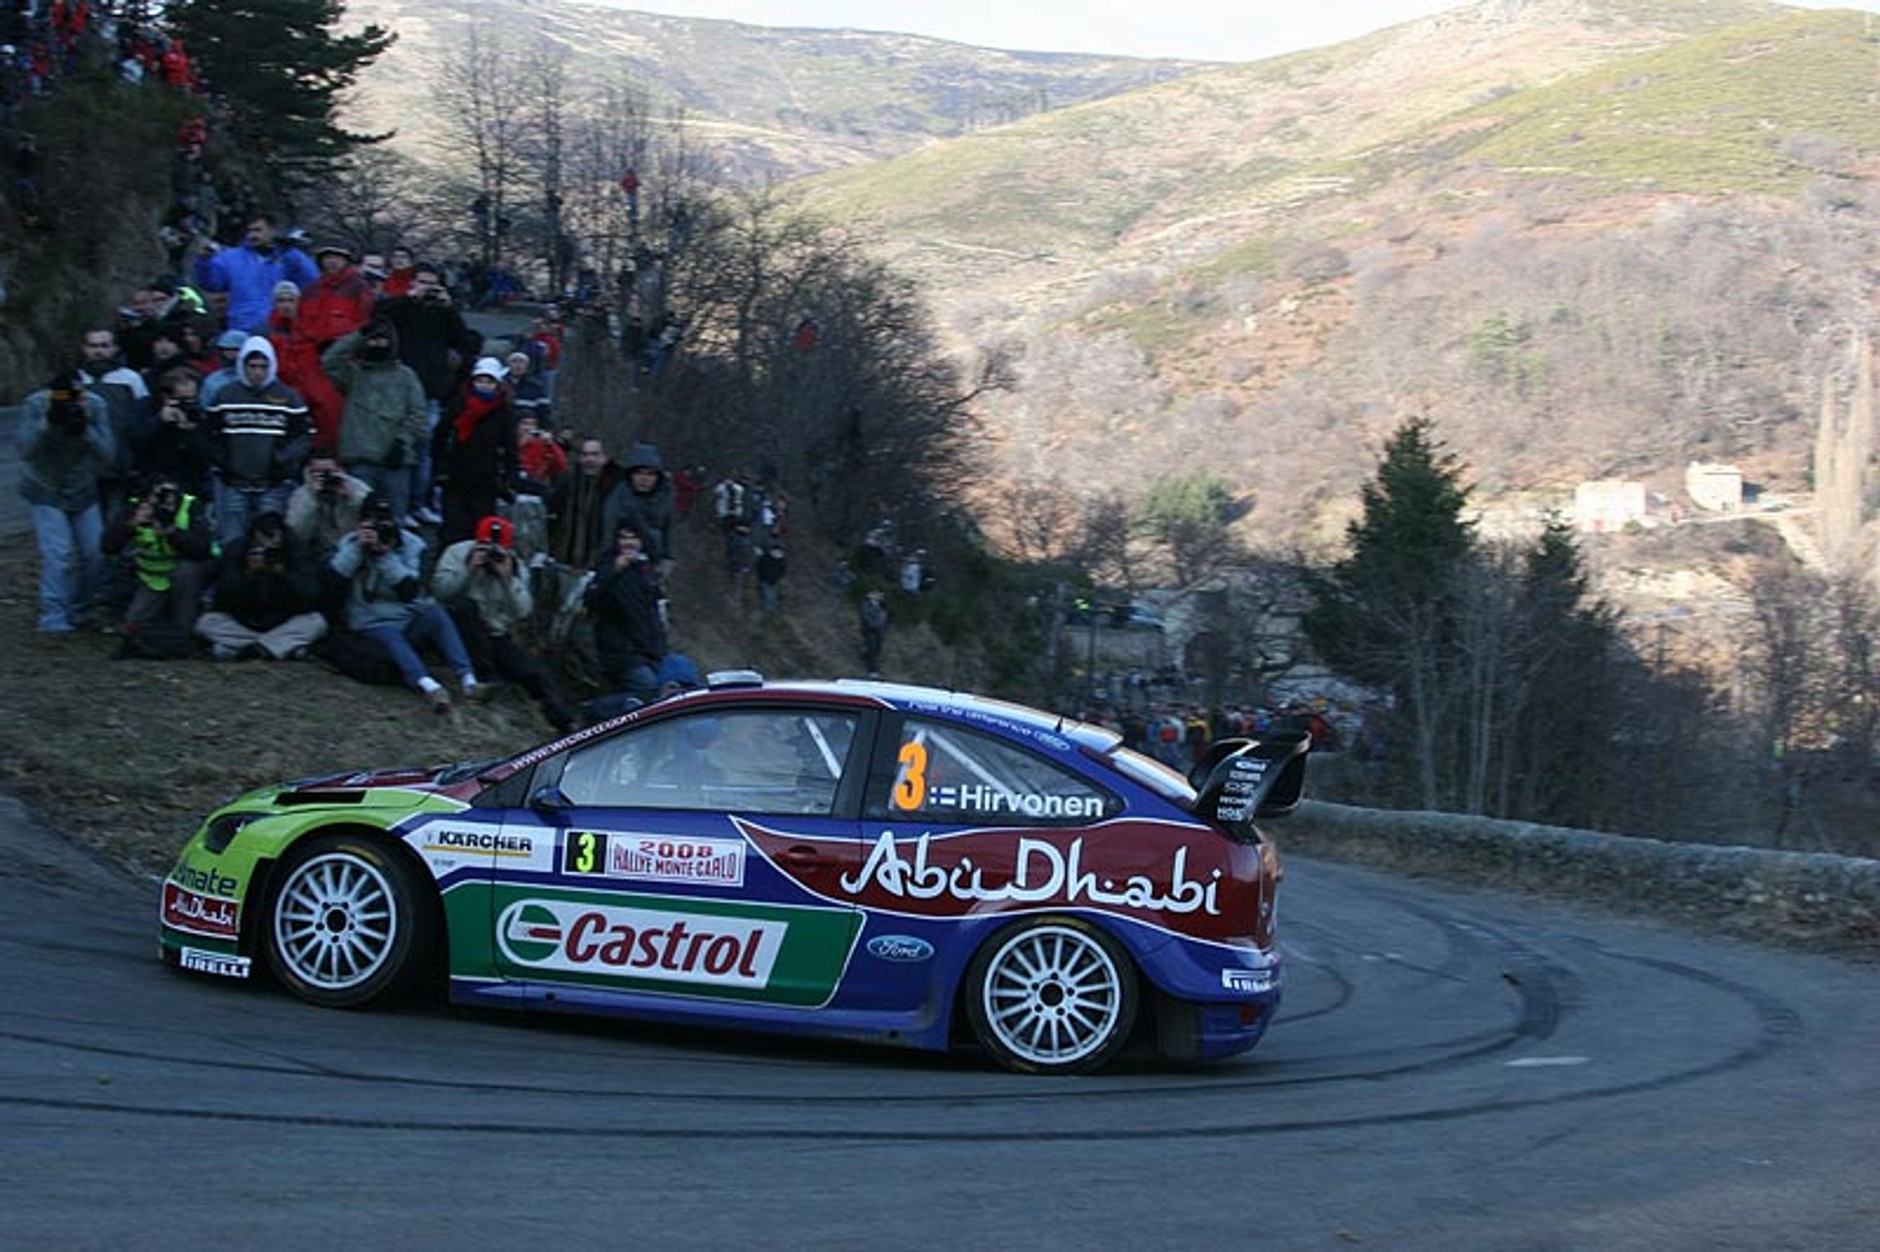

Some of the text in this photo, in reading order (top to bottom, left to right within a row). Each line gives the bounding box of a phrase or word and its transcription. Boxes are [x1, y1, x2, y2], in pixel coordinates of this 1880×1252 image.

[895, 742, 927, 811] 3
[959, 784, 1105, 817] Hirvonen
[438, 830, 533, 851] KÄRCHER
[576, 832, 596, 874] 3
[639, 841, 714, 859] 2008
[613, 843, 651, 873] RALLYE
[564, 911, 764, 978] Castrol
[878, 938, 922, 959] Ford
